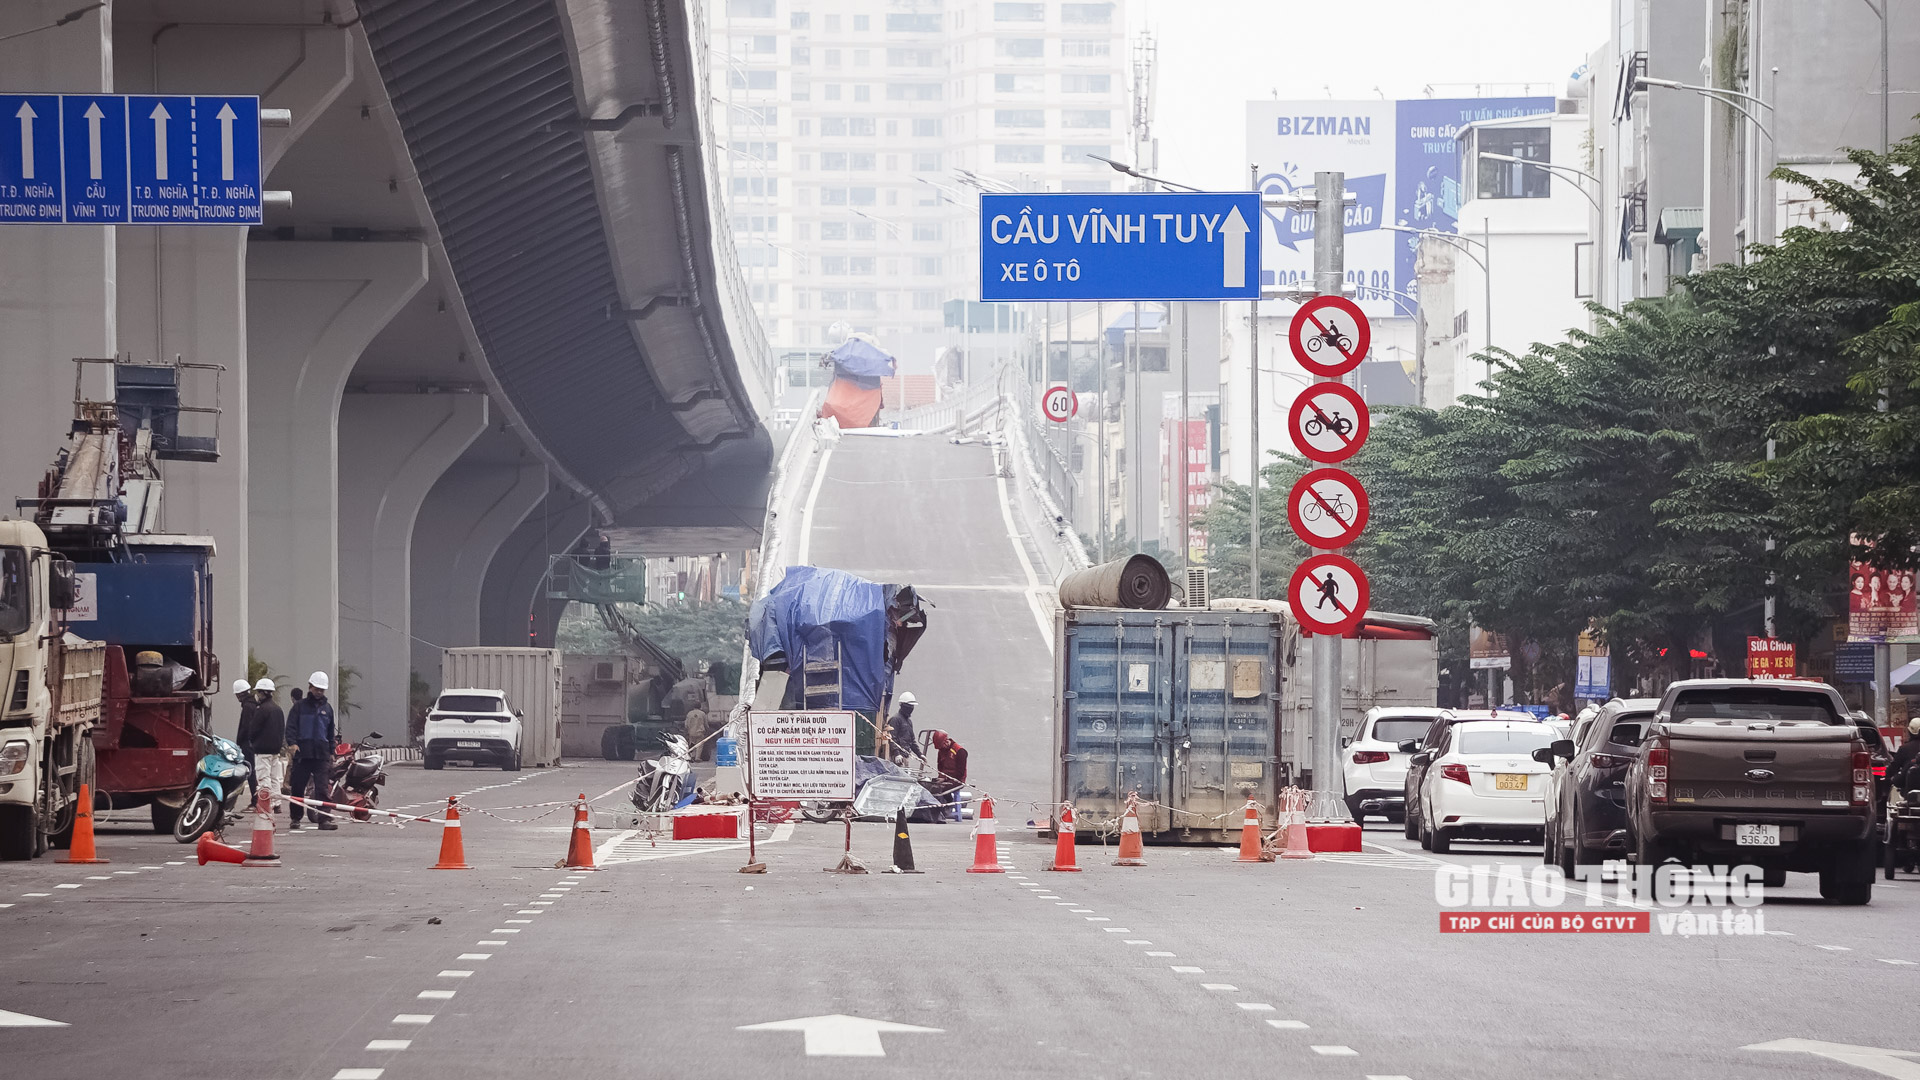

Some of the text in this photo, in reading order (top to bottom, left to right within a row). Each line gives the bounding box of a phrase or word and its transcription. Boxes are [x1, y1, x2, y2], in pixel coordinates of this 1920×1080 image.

[1475, 107, 1492, 120] VẤN
[1278, 117, 1370, 135] BIZMAN
[1410, 124, 1456, 138] CUNG CẤP
[24, 182, 55, 198] NGHĨA
[159, 183, 188, 199] NGHĨA
[226, 184, 255, 199] NGHĨA
[0, 204, 61, 219] TRƯƠNG ĐỊNH
[73, 202, 120, 217] VĨNH TUY
[132, 204, 194, 219] TRƯƠNG ĐỊNH
[199, 204, 260, 220] TRƯƠNG ĐỊNH
[1344, 204, 1372, 227] CÁO
[991, 205, 1220, 244] CẦU VĨNH TUY
[1000, 258, 1080, 282] XE Ô TÔ
[1052, 397, 1068, 412] 60
[1761, 657, 1769, 668] GA
[1775, 657, 1783, 668] XE
[1785, 654, 1793, 668] SỐ
[1674, 787, 1846, 800] RANGER
[1749, 826, 1767, 834] 29H
[1741, 836, 1775, 844] 536.20
